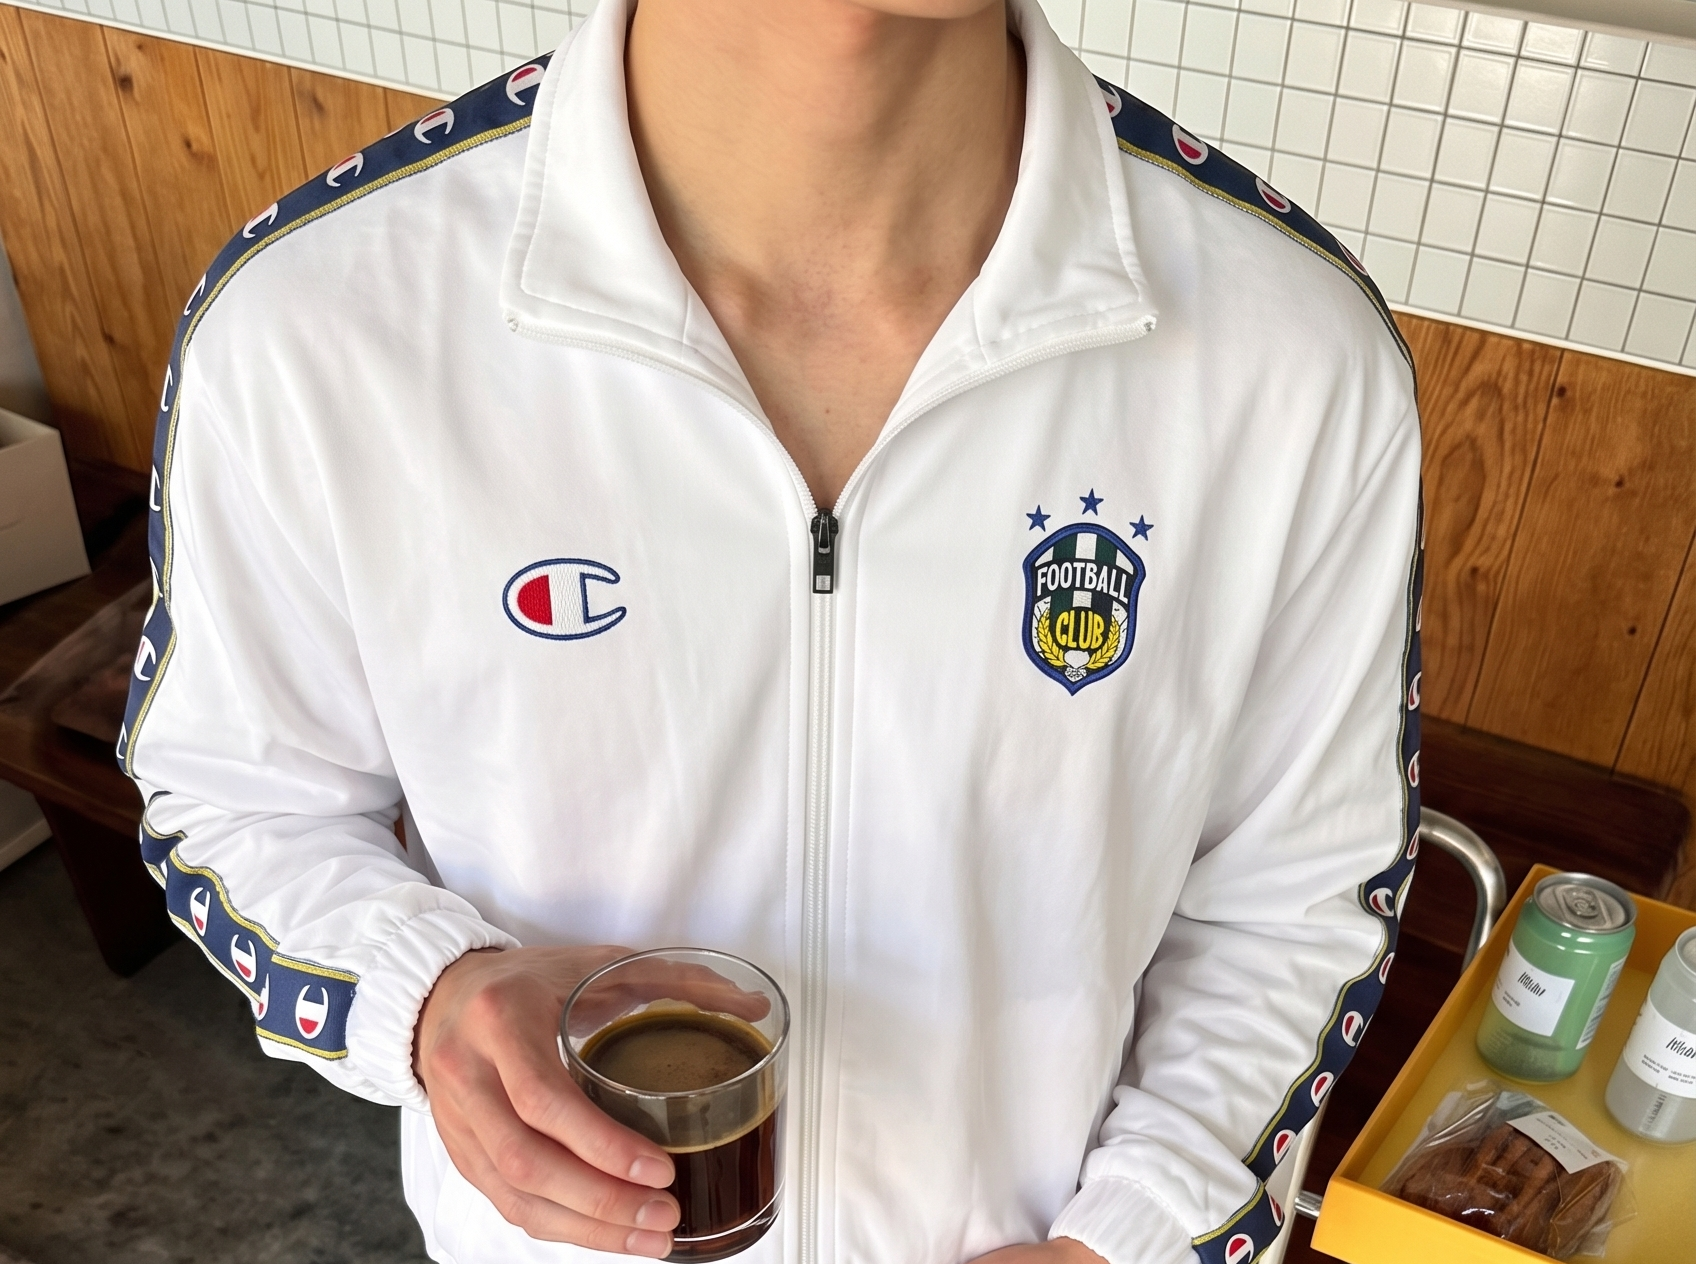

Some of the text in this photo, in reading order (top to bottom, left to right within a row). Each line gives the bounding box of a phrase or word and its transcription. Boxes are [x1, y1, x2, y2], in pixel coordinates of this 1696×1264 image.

[502, 558, 627, 640] C
[1037, 562, 1129, 604] FOOTBALL
[1056, 610, 1105, 649] CLUB
